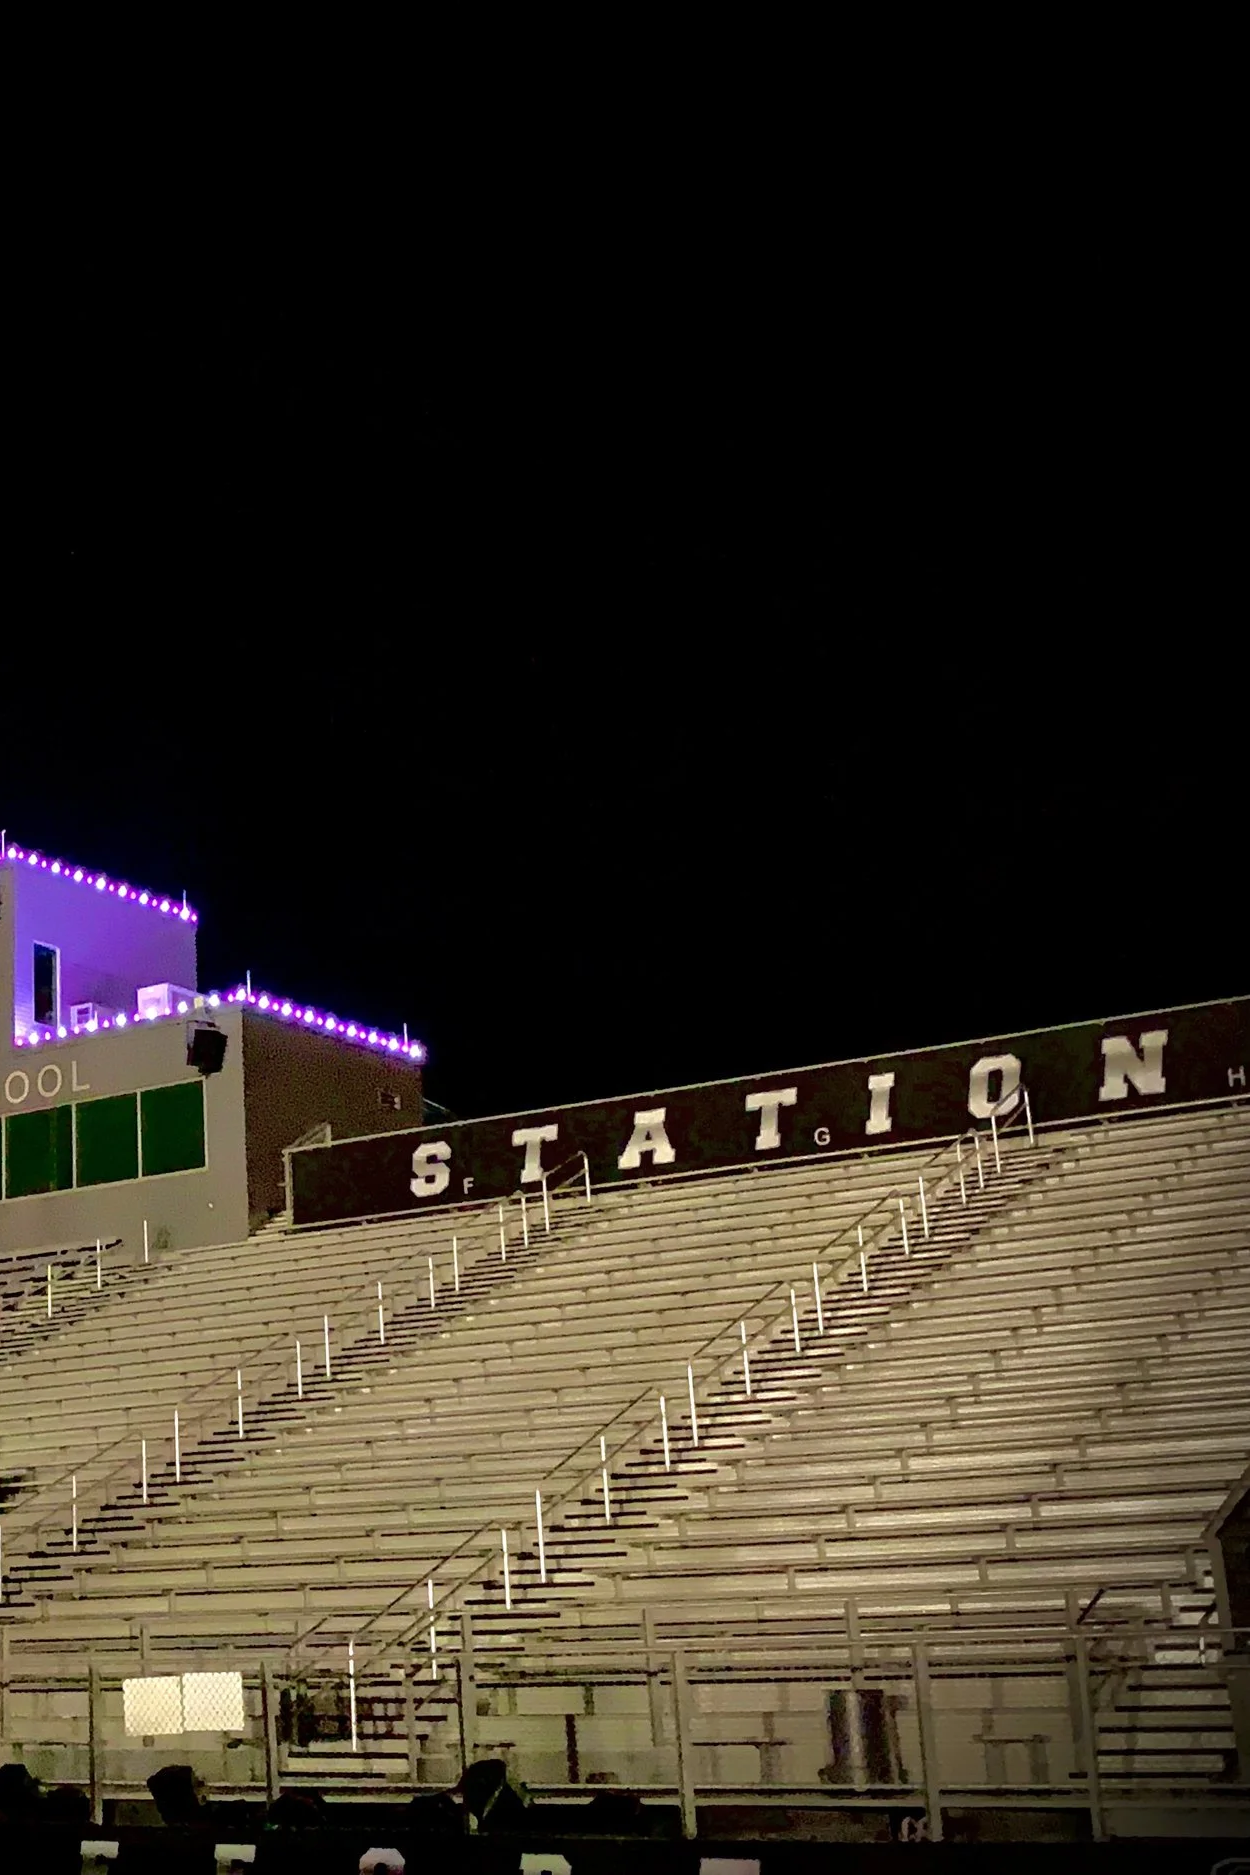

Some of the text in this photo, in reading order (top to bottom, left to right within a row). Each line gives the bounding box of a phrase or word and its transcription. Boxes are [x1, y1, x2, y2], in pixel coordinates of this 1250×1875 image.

[1227, 1065, 1246, 1087] H
[410, 1030, 1168, 1198] STATION
[814, 1127, 831, 1146] G
[464, 1177, 474, 1195] F
